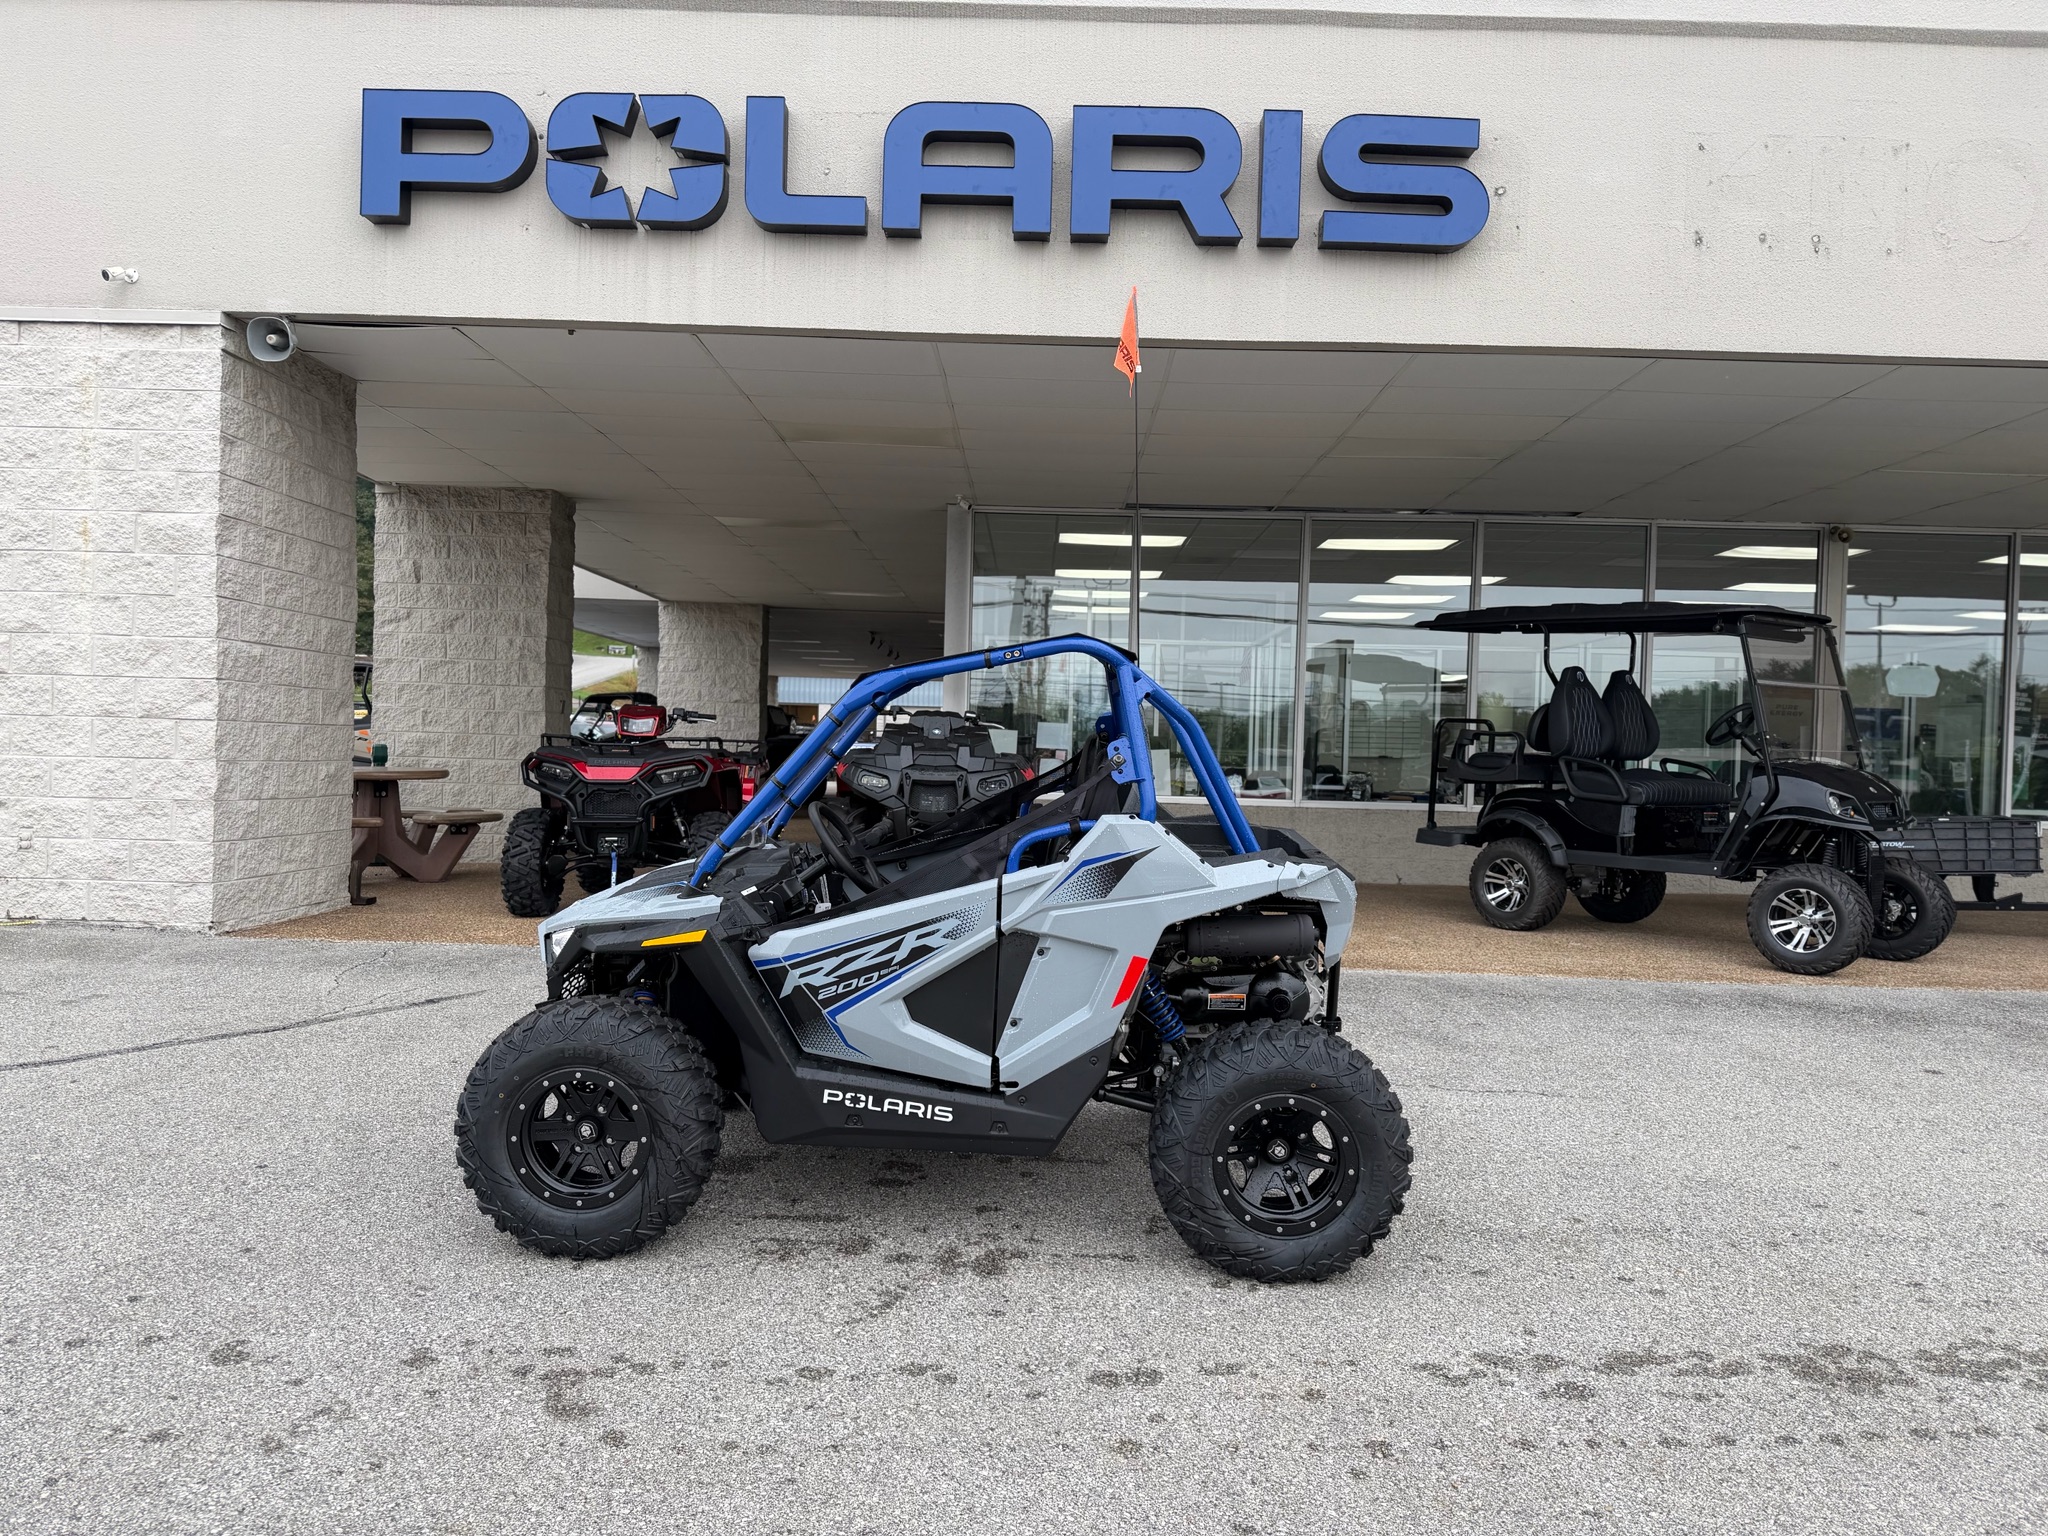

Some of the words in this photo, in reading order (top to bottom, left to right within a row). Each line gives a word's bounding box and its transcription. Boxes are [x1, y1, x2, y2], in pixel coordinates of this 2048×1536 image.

[360, 88, 1490, 253] POLARIS
[779, 918, 962, 999] RZR
[817, 971, 880, 1000] 200
[822, 1088, 954, 1122] POLARIS
